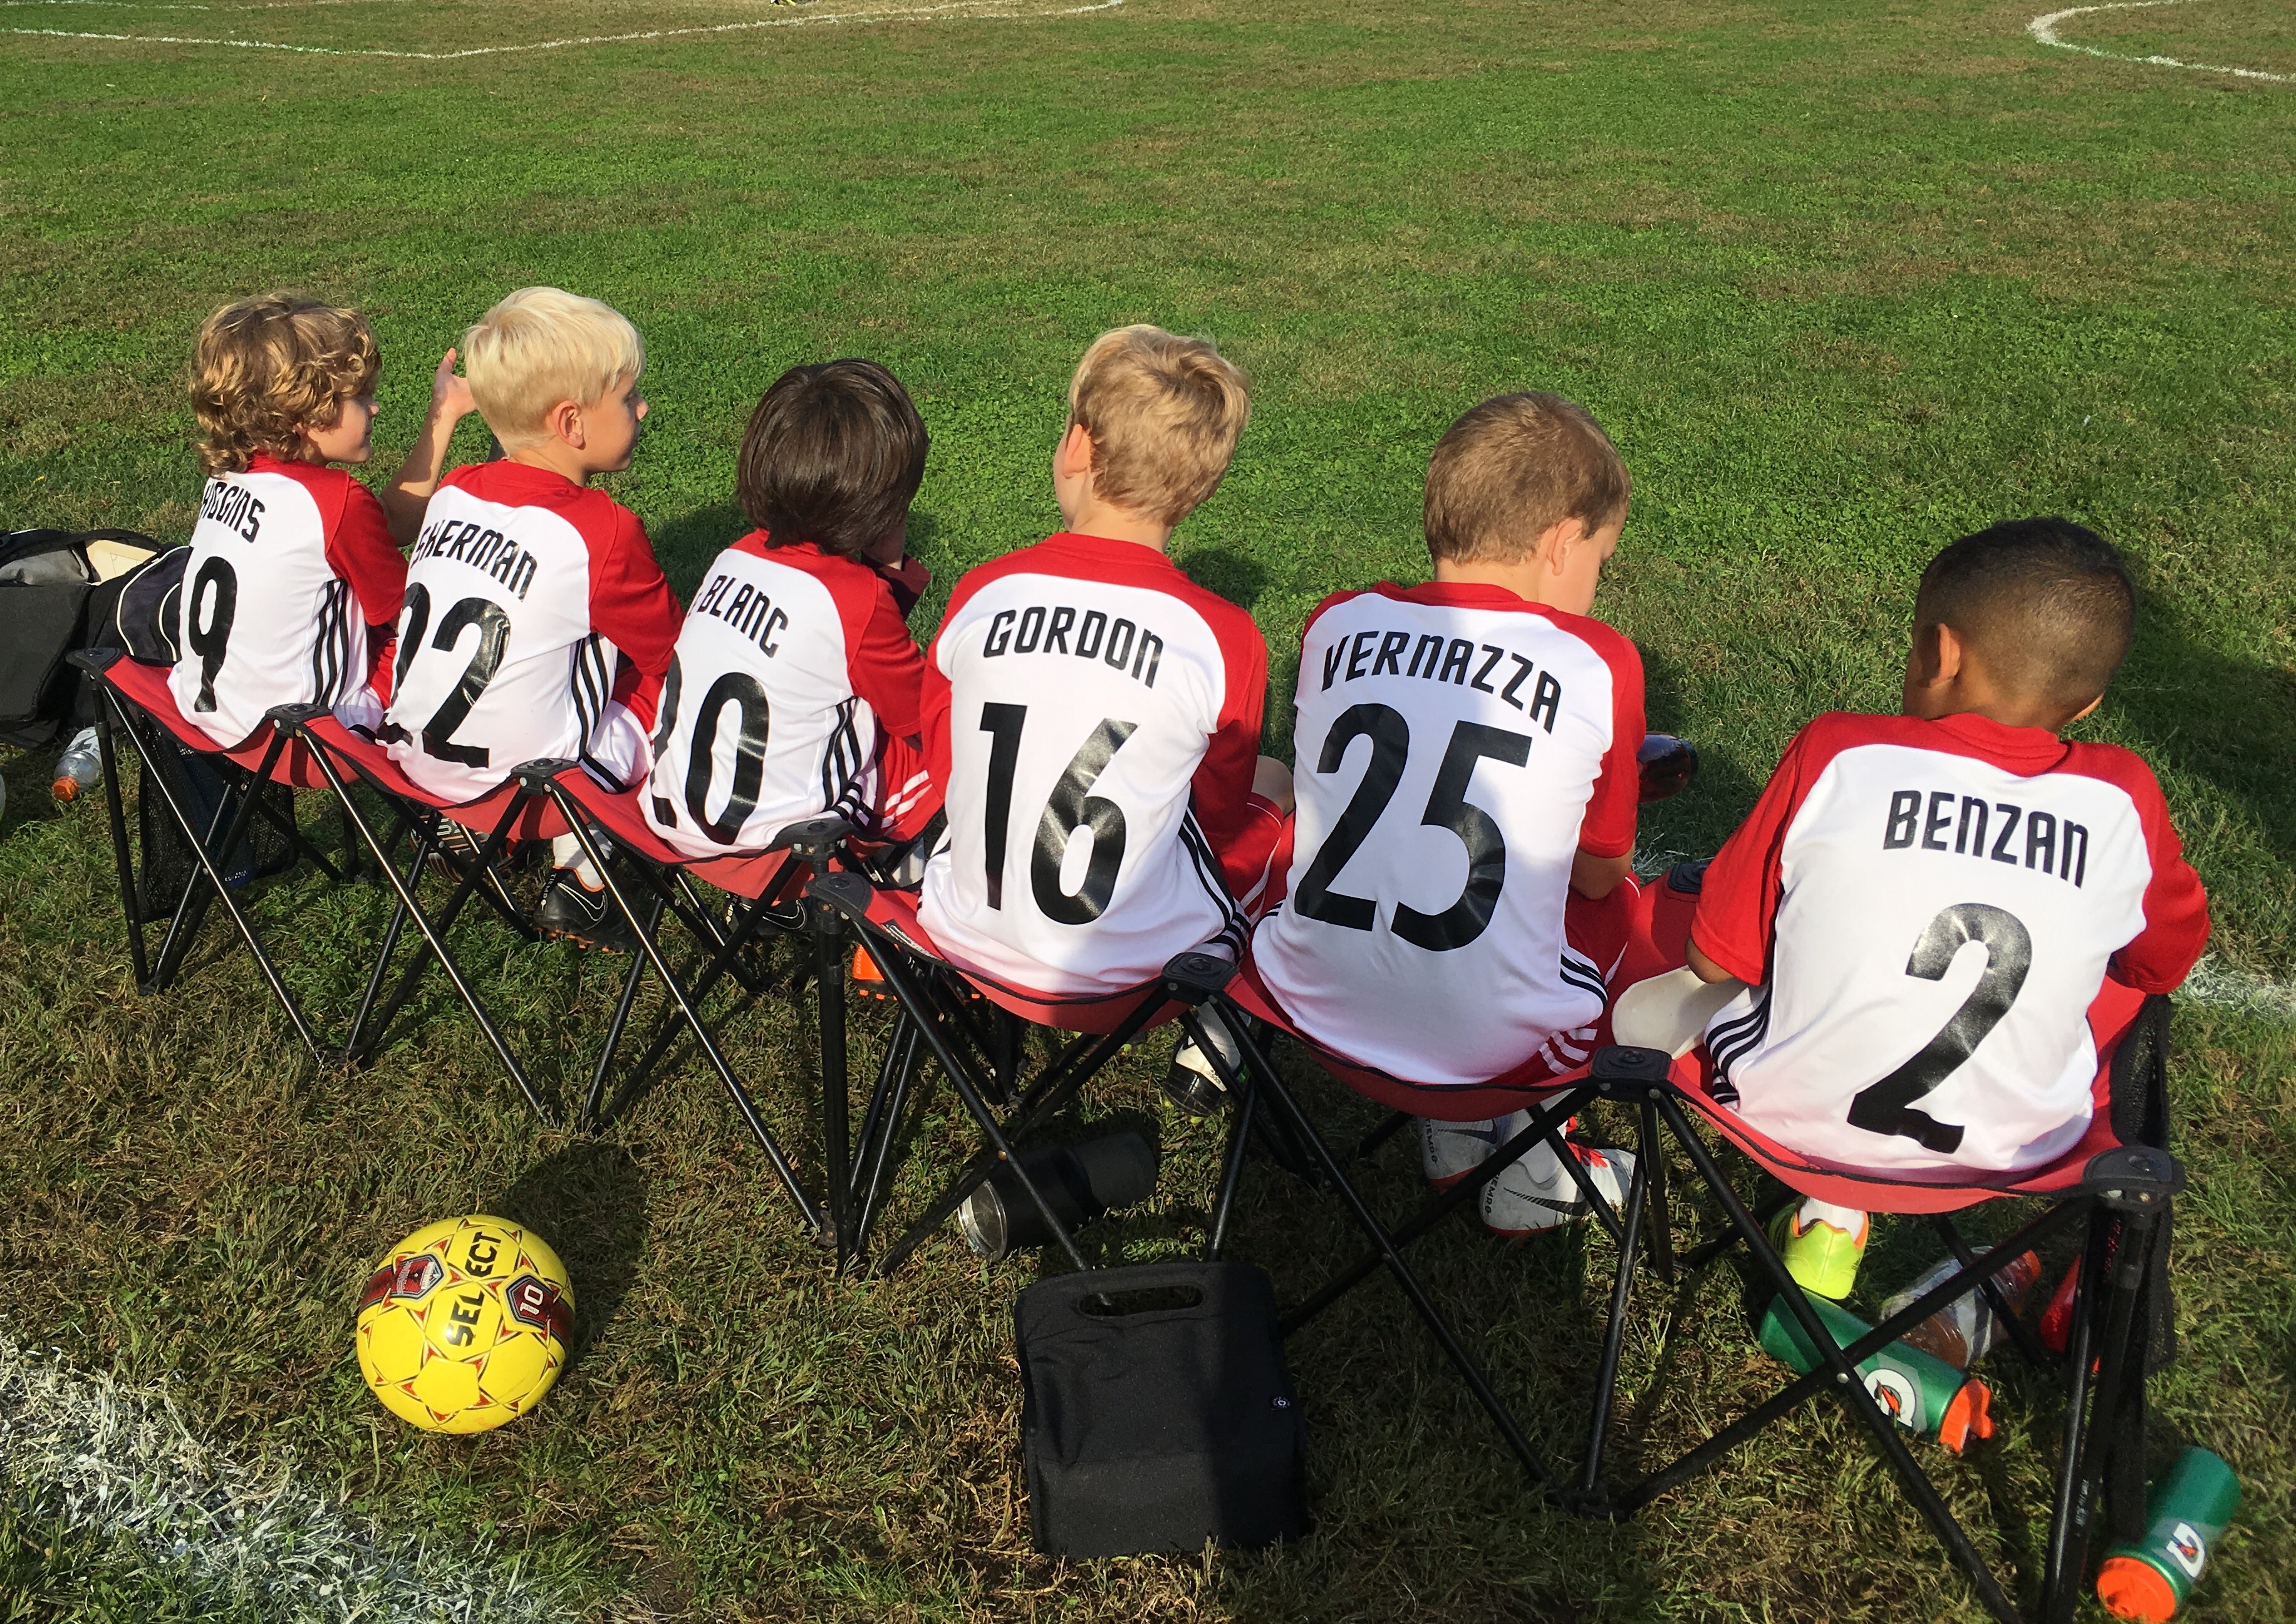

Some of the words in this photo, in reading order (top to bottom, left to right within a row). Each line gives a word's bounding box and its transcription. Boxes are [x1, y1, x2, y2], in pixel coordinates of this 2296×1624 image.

[199, 482, 265, 543] HIGGINS
[410, 520, 538, 602] SHERMAN
[189, 556, 237, 712] 9
[376, 582, 511, 769] 22
[983, 606, 1164, 689] GORDON
[1321, 631, 1561, 735] VERNAZZA
[979, 701, 1141, 926] 16
[1294, 703, 1533, 952] 25
[1883, 790, 2090, 889] BENZAN
[1847, 903, 2032, 1154] 2
[445, 1231, 501, 1348] SELECT
[519, 1284, 544, 1315] 10
